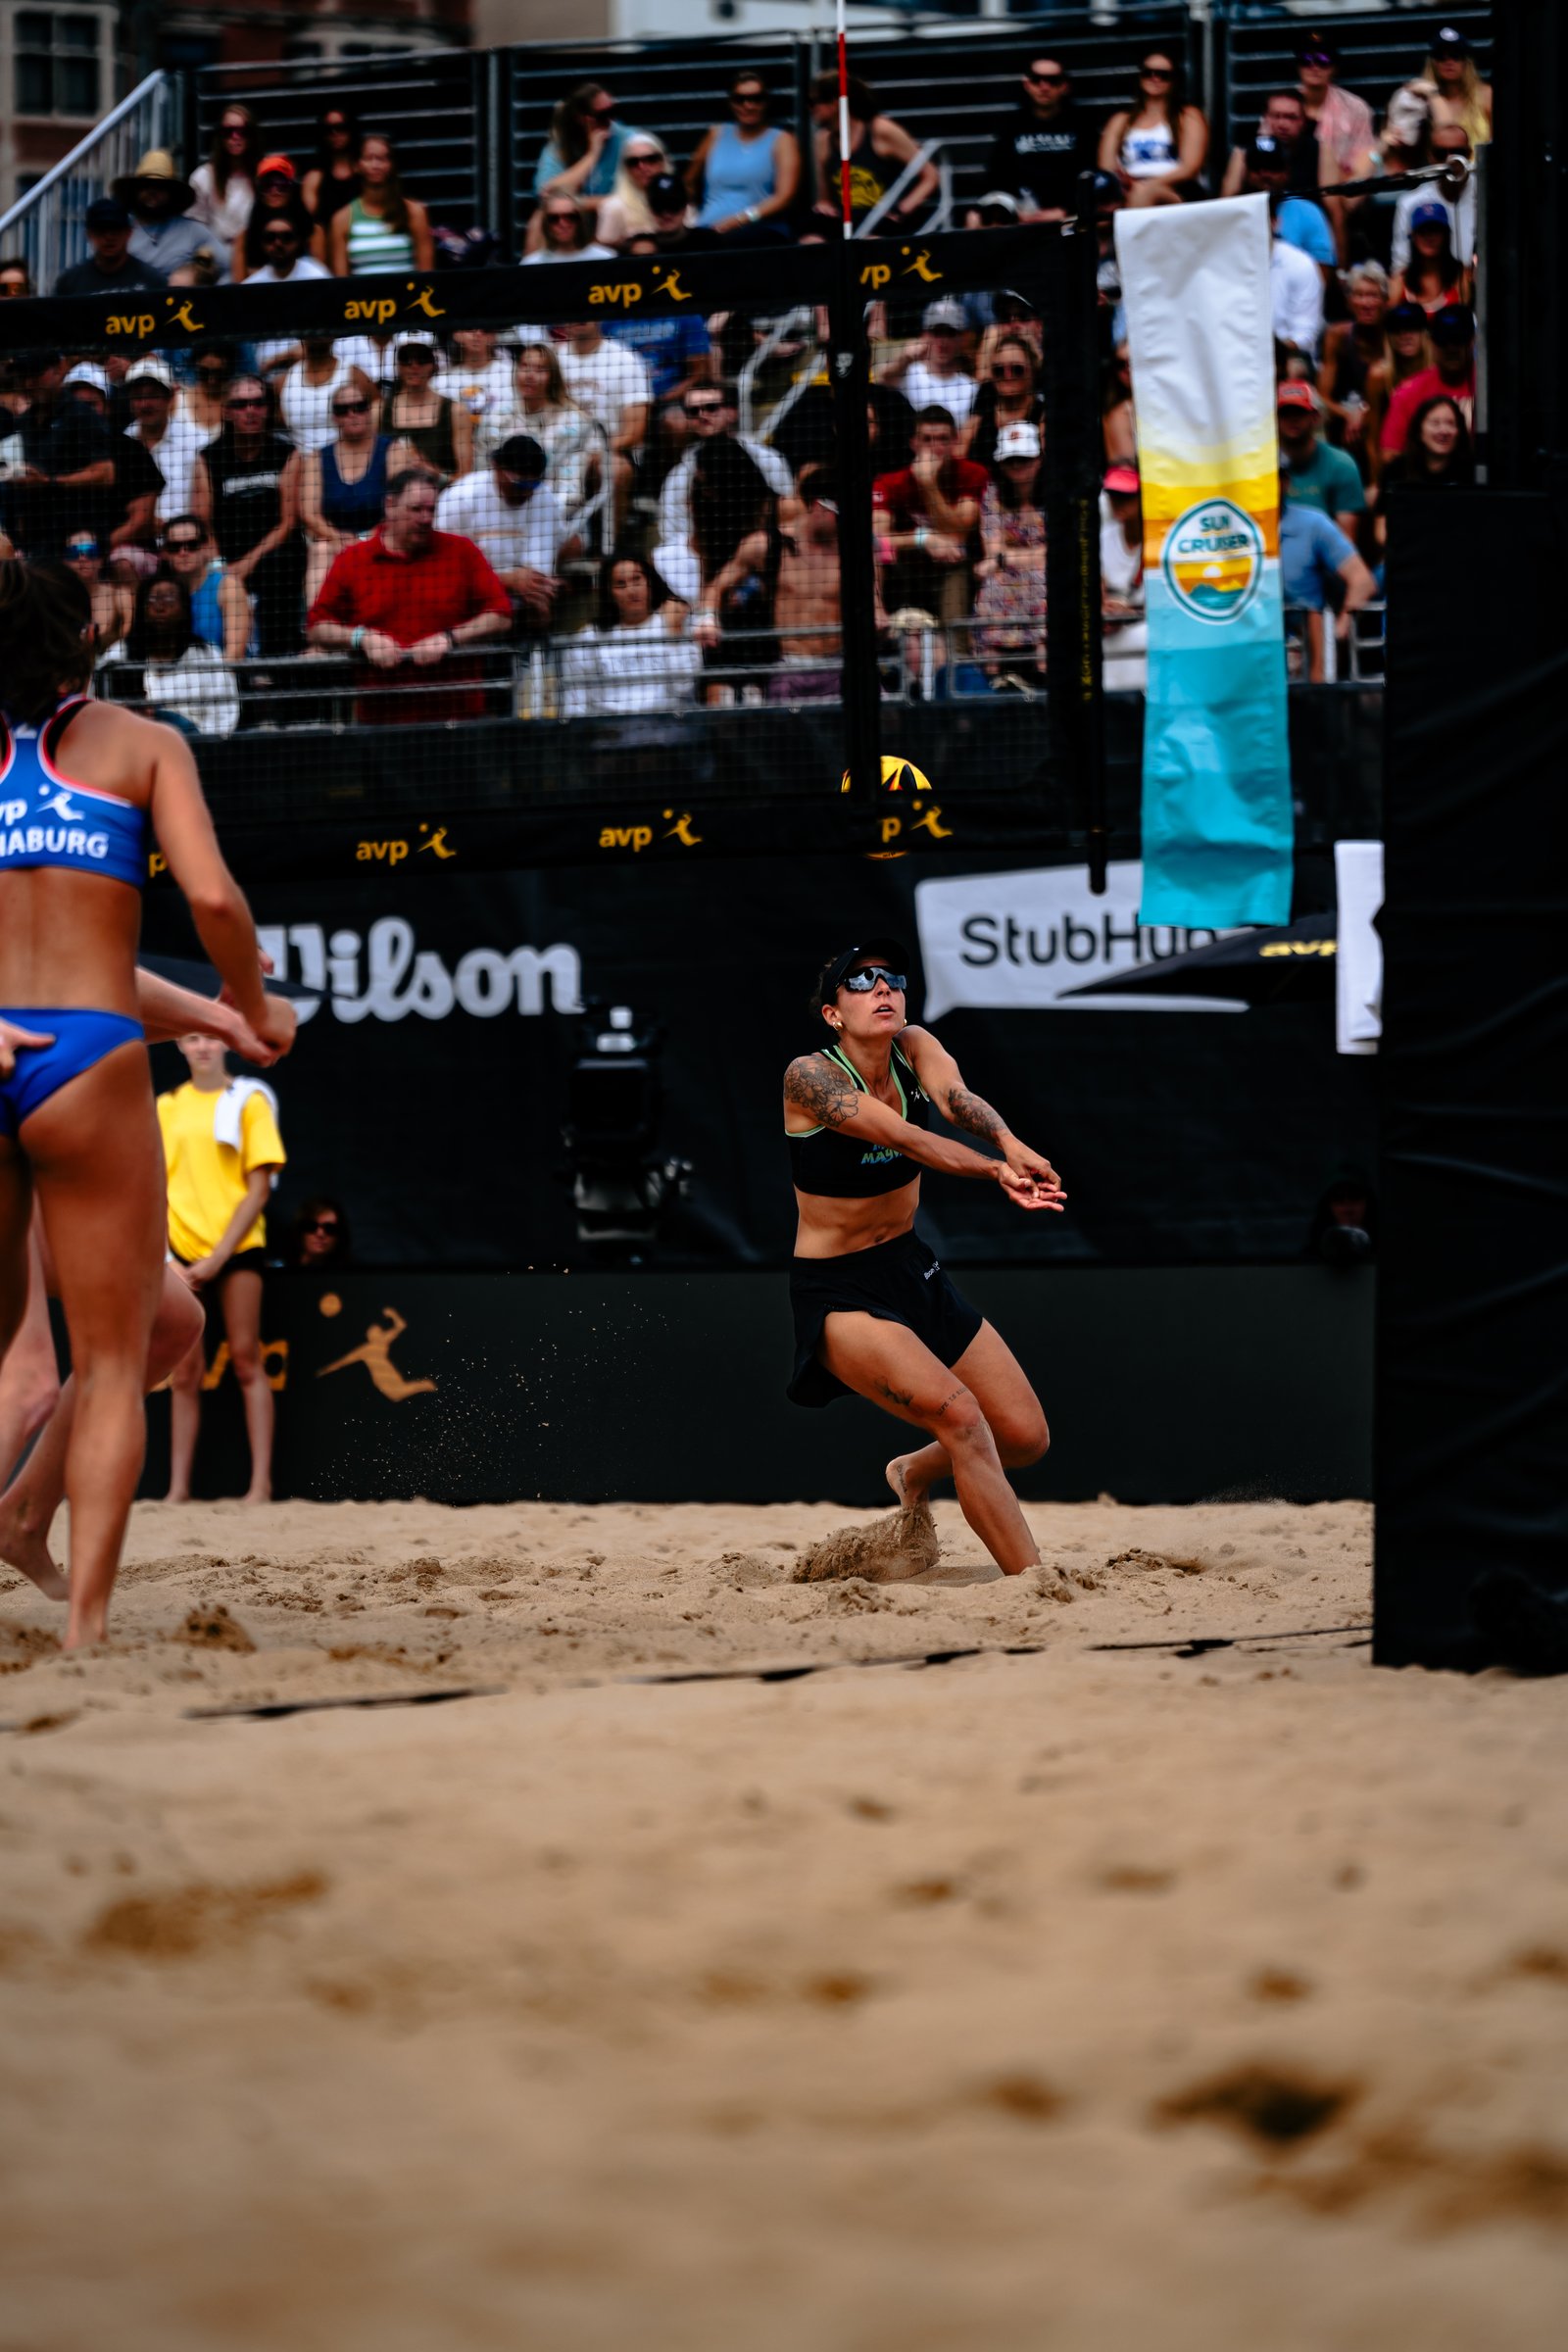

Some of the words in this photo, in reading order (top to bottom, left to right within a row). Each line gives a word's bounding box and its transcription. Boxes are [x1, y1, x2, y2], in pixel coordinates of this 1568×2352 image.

[859, 264, 891, 290] vp
[589, 282, 642, 309] avp
[344, 298, 397, 325] avp
[105, 314, 155, 339] avp
[356, 839, 410, 866] avp
[599, 825, 653, 853] avp
